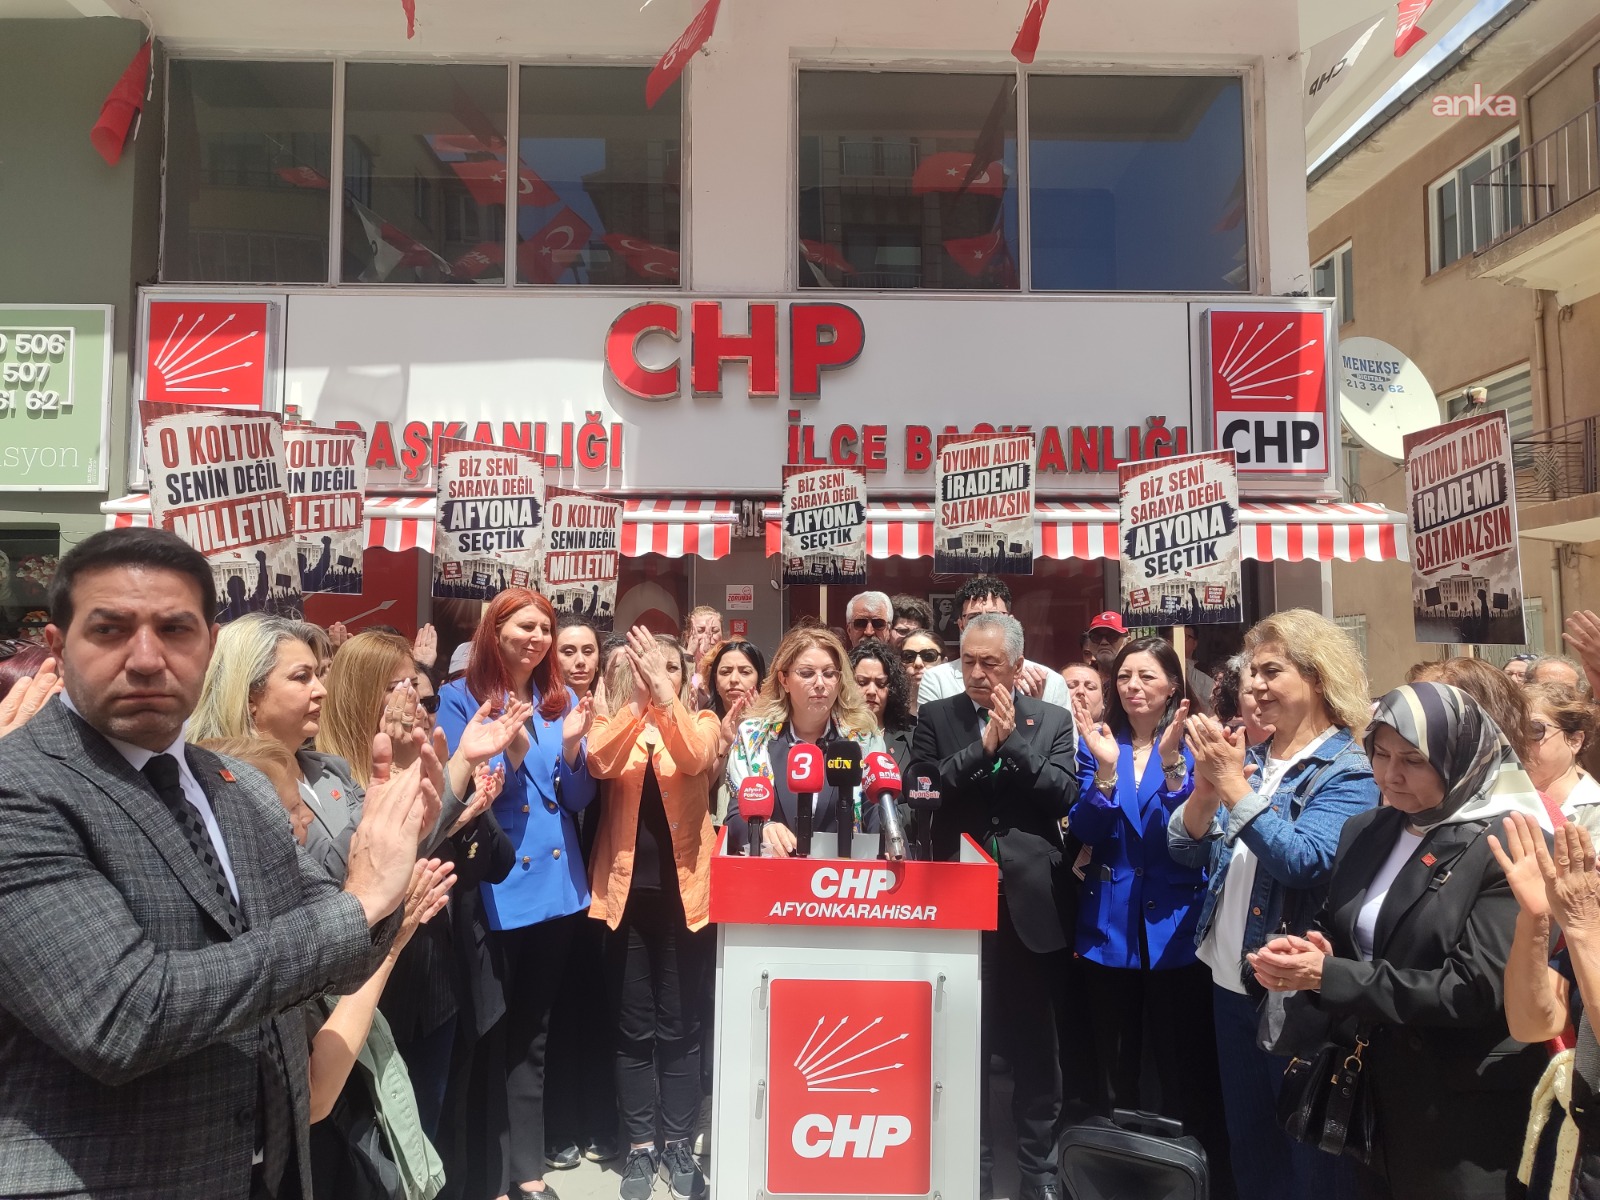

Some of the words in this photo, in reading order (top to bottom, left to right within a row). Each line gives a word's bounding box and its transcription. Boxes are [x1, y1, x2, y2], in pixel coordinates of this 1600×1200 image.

[15, 334, 65, 354] 506
[604, 301, 865, 400] CHP
[3, 363, 50, 383] 507
[1346, 379, 1366, 390] 213
[1370, 383, 1384, 392] 34
[1388, 385, 1404, 393] 62
[26, 390, 59, 410] 62
[160, 427, 179, 468] O
[187, 423, 275, 466] KOLTUK
[335, 411, 624, 481] AŞKNLIĞI
[904, 416, 1188, 475] BANLIĞI
[943, 445, 990, 474] OYUMU
[993, 439, 1029, 465] ALDIN
[1222, 419, 1319, 463] CHP
[1411, 440, 1458, 491] OYUMU
[1461, 421, 1502, 471] ALDIN
[0, 446, 79, 475] syon
[459, 456, 481, 477] BİZ
[486, 455, 518, 476] SENİ
[166, 466, 229, 505] SENİN
[233, 459, 281, 494] DEĞİL
[312, 467, 357, 492] DEĞİL
[449, 480, 498, 498] SARAYA
[502, 476, 534, 496] DEĞİL
[798, 476, 816, 494] BİZ
[819, 470, 845, 490] SENİ
[947, 464, 1024, 499] İRADEMİ
[1140, 476, 1164, 501] BİZ
[1169, 461, 1205, 492] SENİ
[295, 494, 355, 530] LETİN
[791, 492, 830, 510] SARAYA
[833, 485, 858, 503] DEĞİL
[942, 490, 1030, 526] SATAMAZSIN
[1131, 494, 1184, 524] SARAYA
[1188, 480, 1226, 508] DEĞİL
[1417, 463, 1499, 529] İRADEMİ
[173, 495, 287, 552] MİLLETİN
[450, 499, 532, 530] AFYONA
[552, 503, 562, 527] O
[567, 504, 617, 528] KOLTUK
[793, 503, 858, 534] AFYONA
[459, 528, 525, 554] SEÇTİK
[550, 529, 586, 549] SENİN
[589, 529, 616, 548] DEĞİL
[800, 528, 852, 550] SEÇTİK
[1135, 505, 1226, 557] AFYONA
[1415, 505, 1512, 571] SATAMAZSIN
[550, 551, 615, 581] MİLLETİN
[1145, 541, 1218, 578] SEÇTİK
[791, 753, 813, 779] 3
[828, 757, 852, 769] GÜN
[811, 867, 896, 899] CHP
[792, 1113, 912, 1159] CHP
